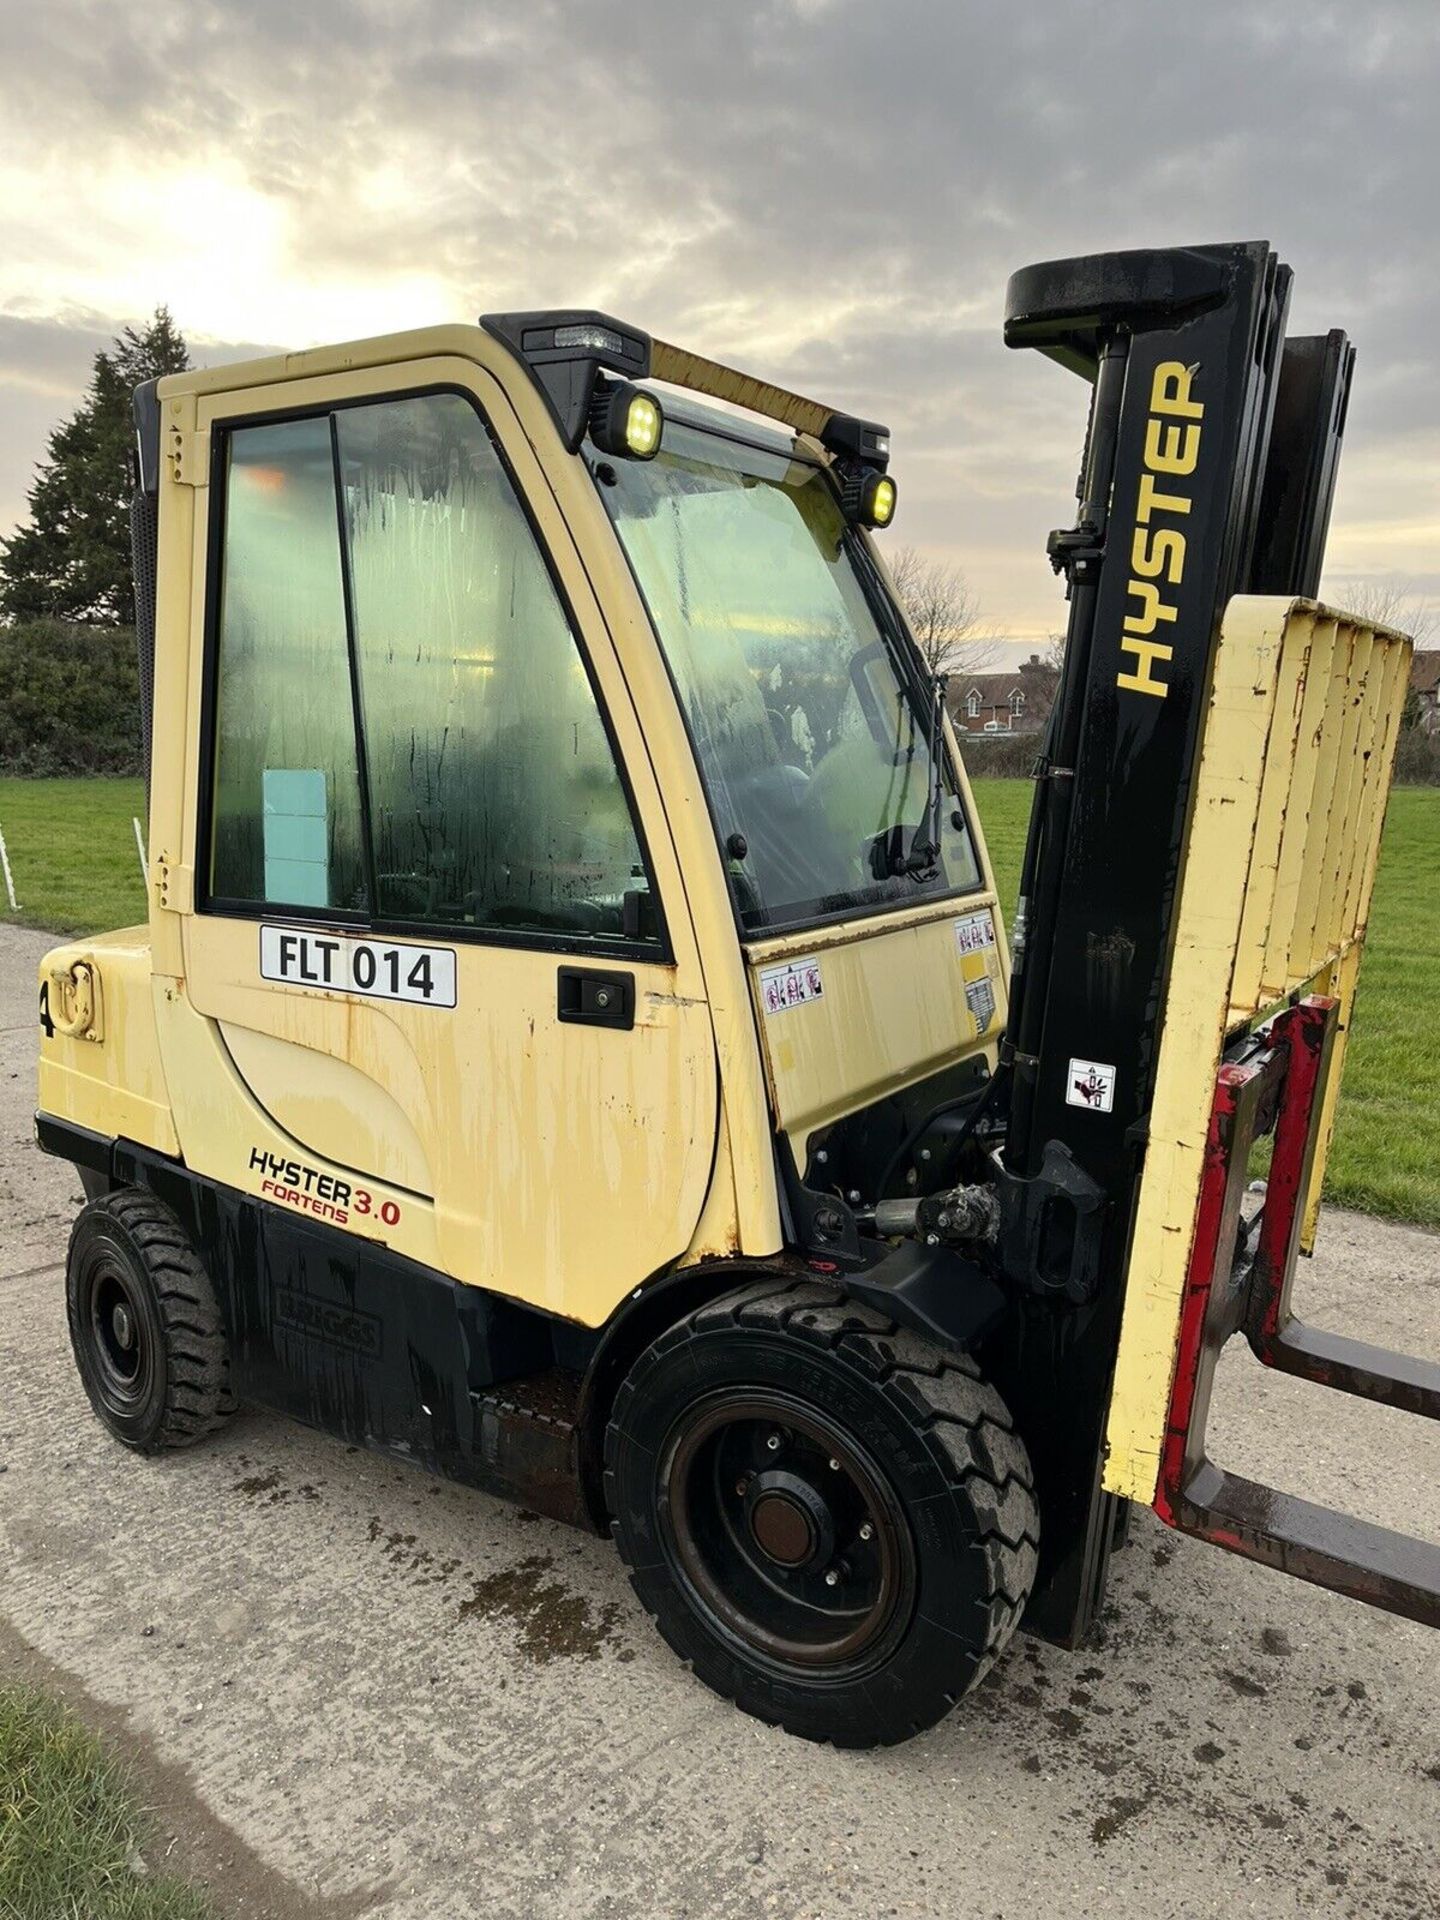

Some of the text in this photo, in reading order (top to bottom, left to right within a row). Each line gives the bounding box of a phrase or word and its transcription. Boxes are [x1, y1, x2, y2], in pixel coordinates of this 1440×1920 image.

[1117, 361, 1204, 697] HYSTER
[280, 935, 434, 998] FLT 014
[249, 1147, 400, 1225] HYSTER 3.0
[262, 1180, 348, 1224] FORTENS
